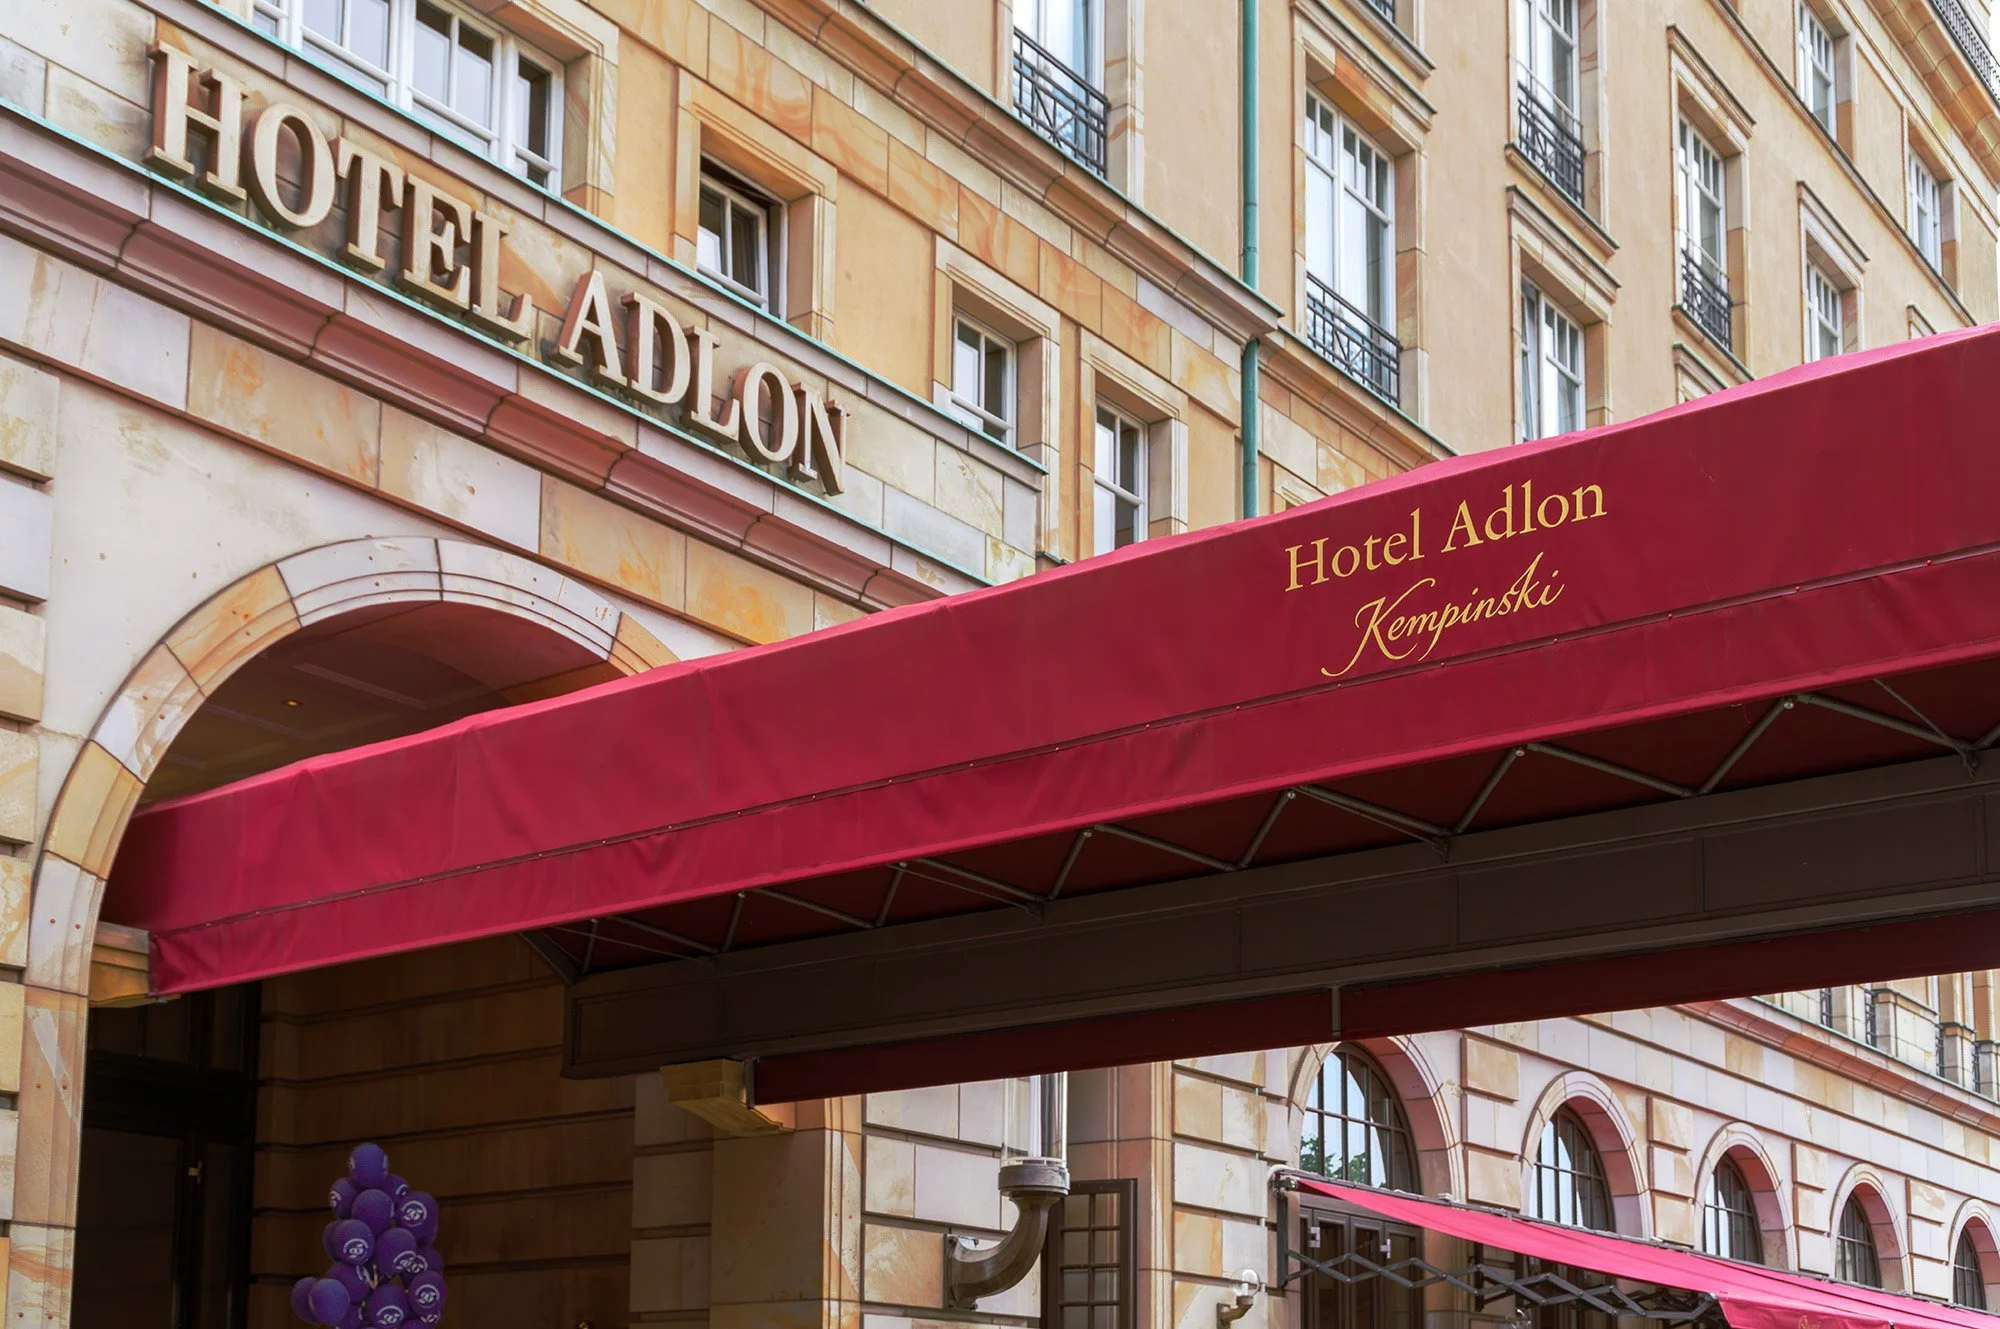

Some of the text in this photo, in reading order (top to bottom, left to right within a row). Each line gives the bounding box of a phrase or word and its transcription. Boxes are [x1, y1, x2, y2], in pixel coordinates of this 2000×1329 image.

[142, 39, 849, 496] HOTEL ADLON
[1284, 479, 1608, 592] Hotel Adlon
[1320, 551, 1565, 677] Kempinski
